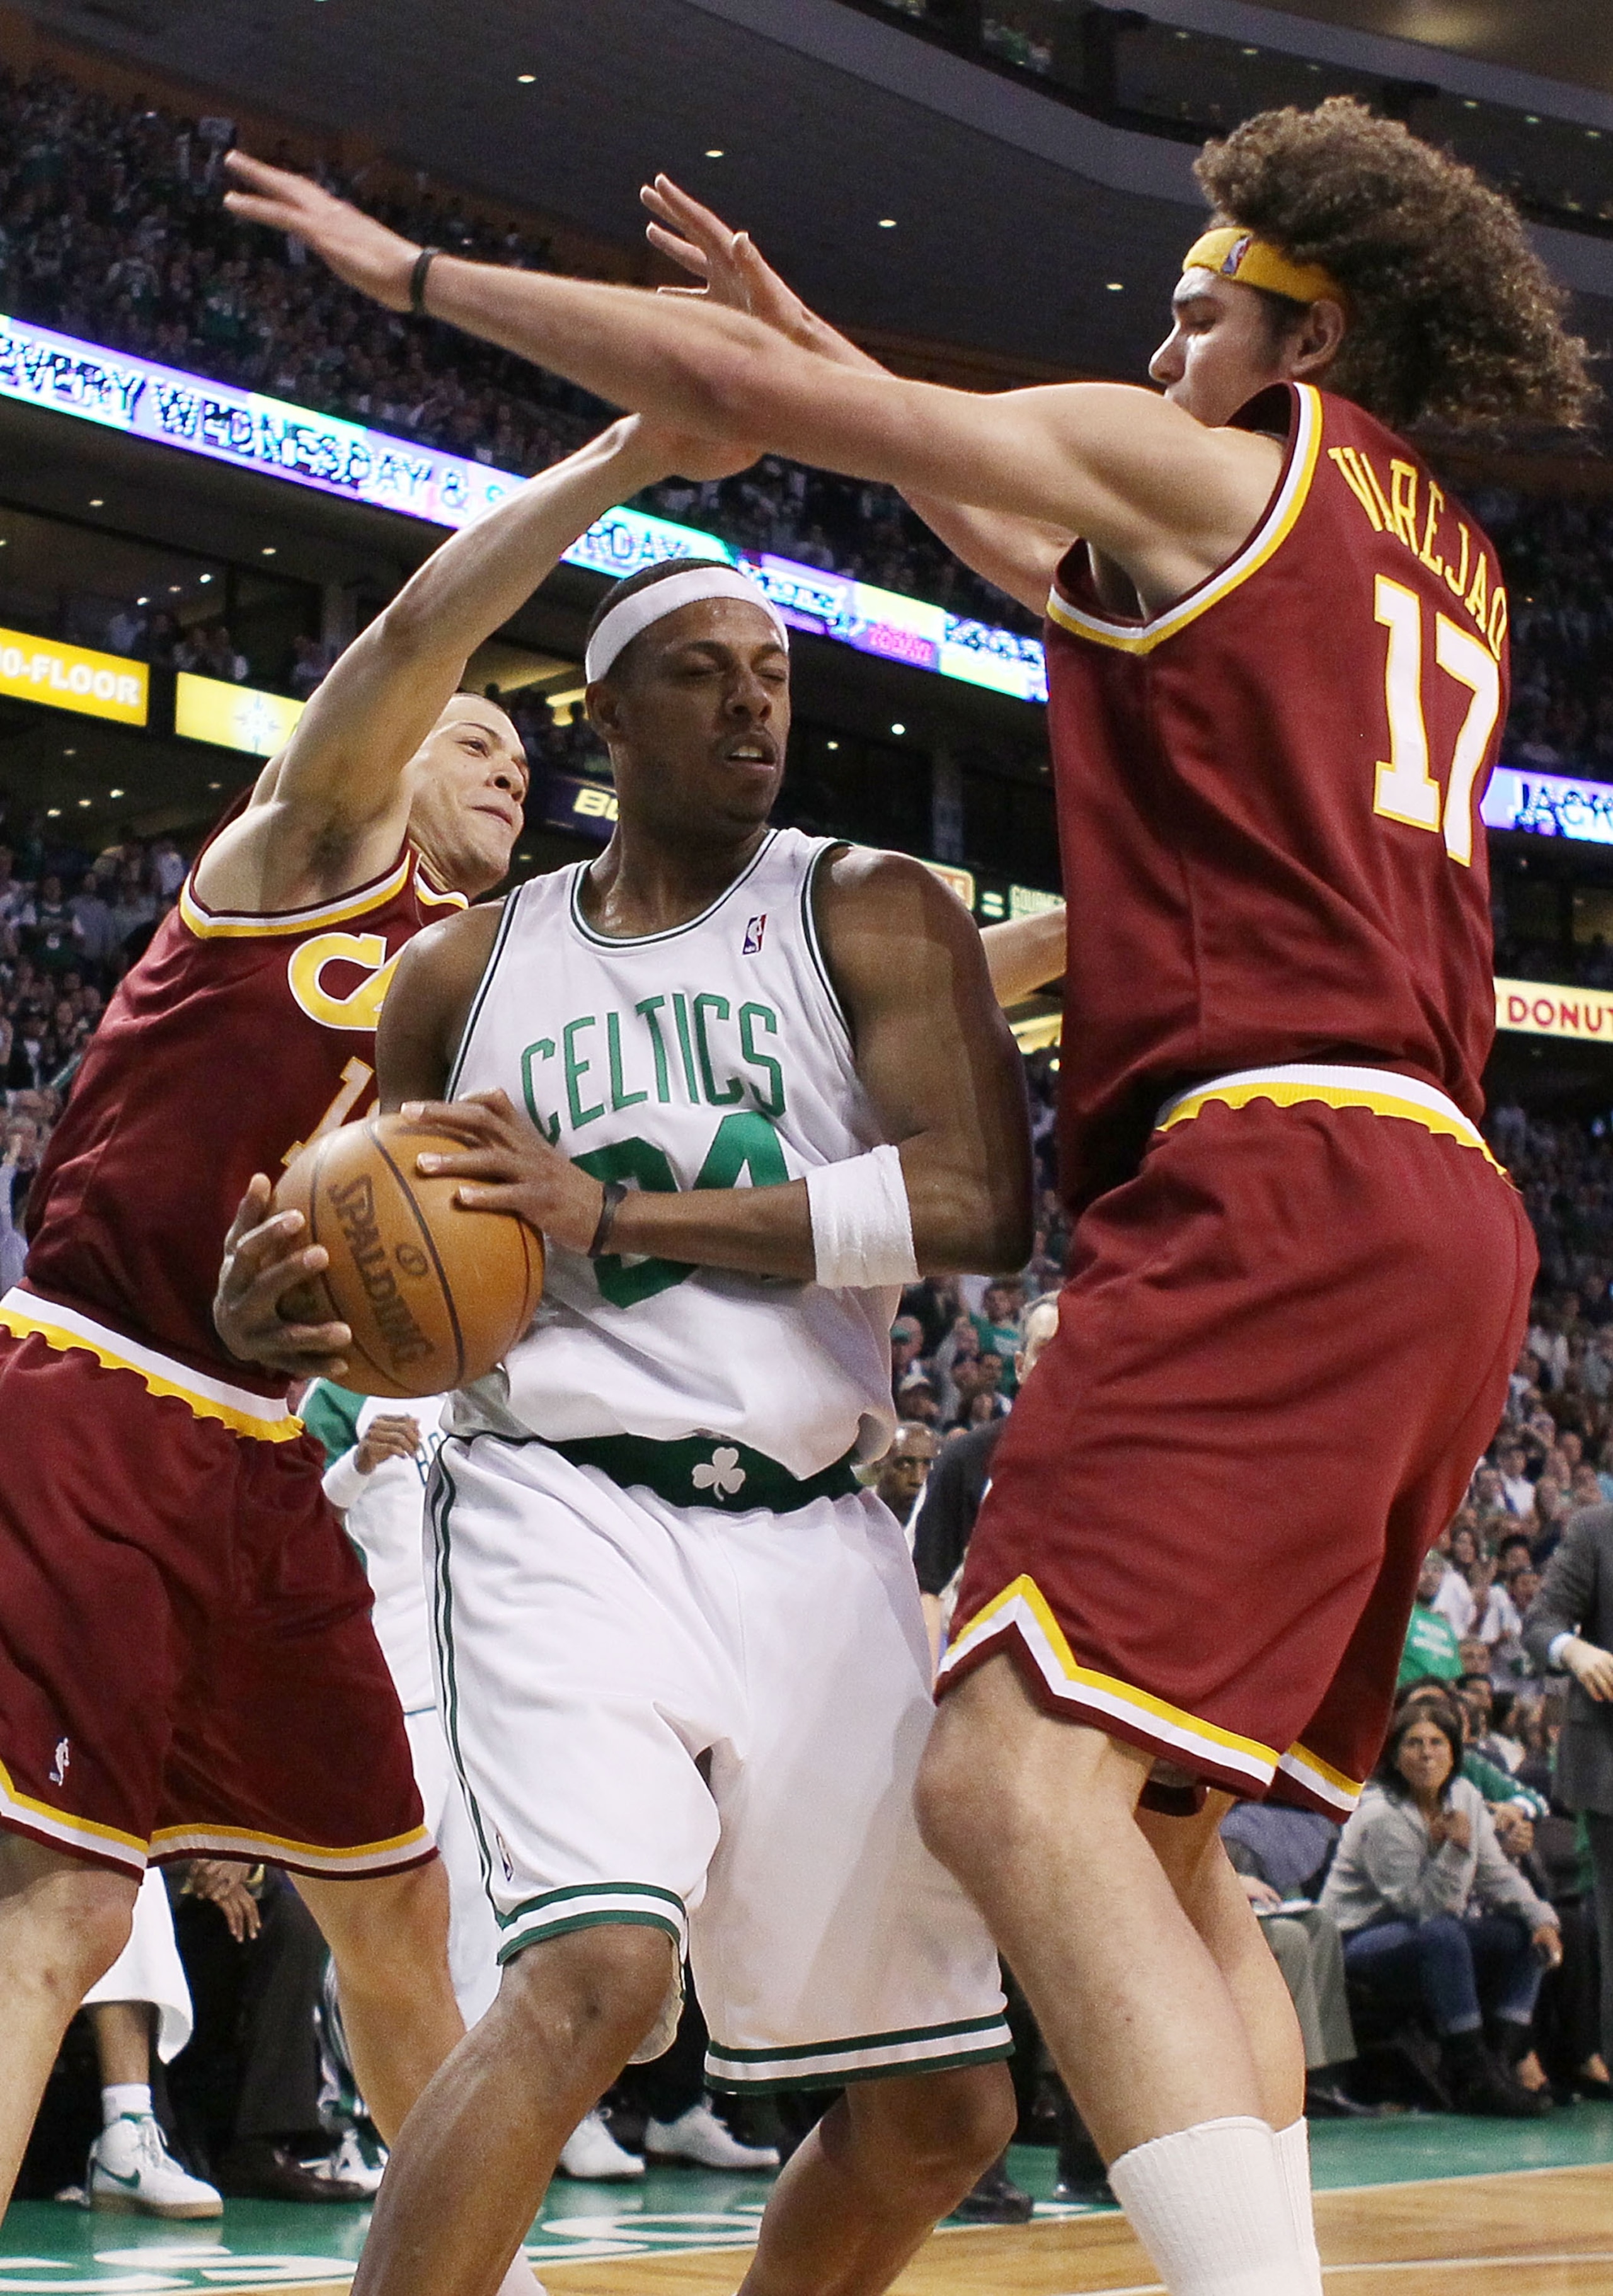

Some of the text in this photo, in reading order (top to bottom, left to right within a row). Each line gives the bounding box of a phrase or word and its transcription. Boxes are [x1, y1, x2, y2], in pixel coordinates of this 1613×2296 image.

[1374, 573, 1498, 867] 17
[521, 992, 786, 1147] CELTICS
[1508, 995, 1613, 1033] DONU
